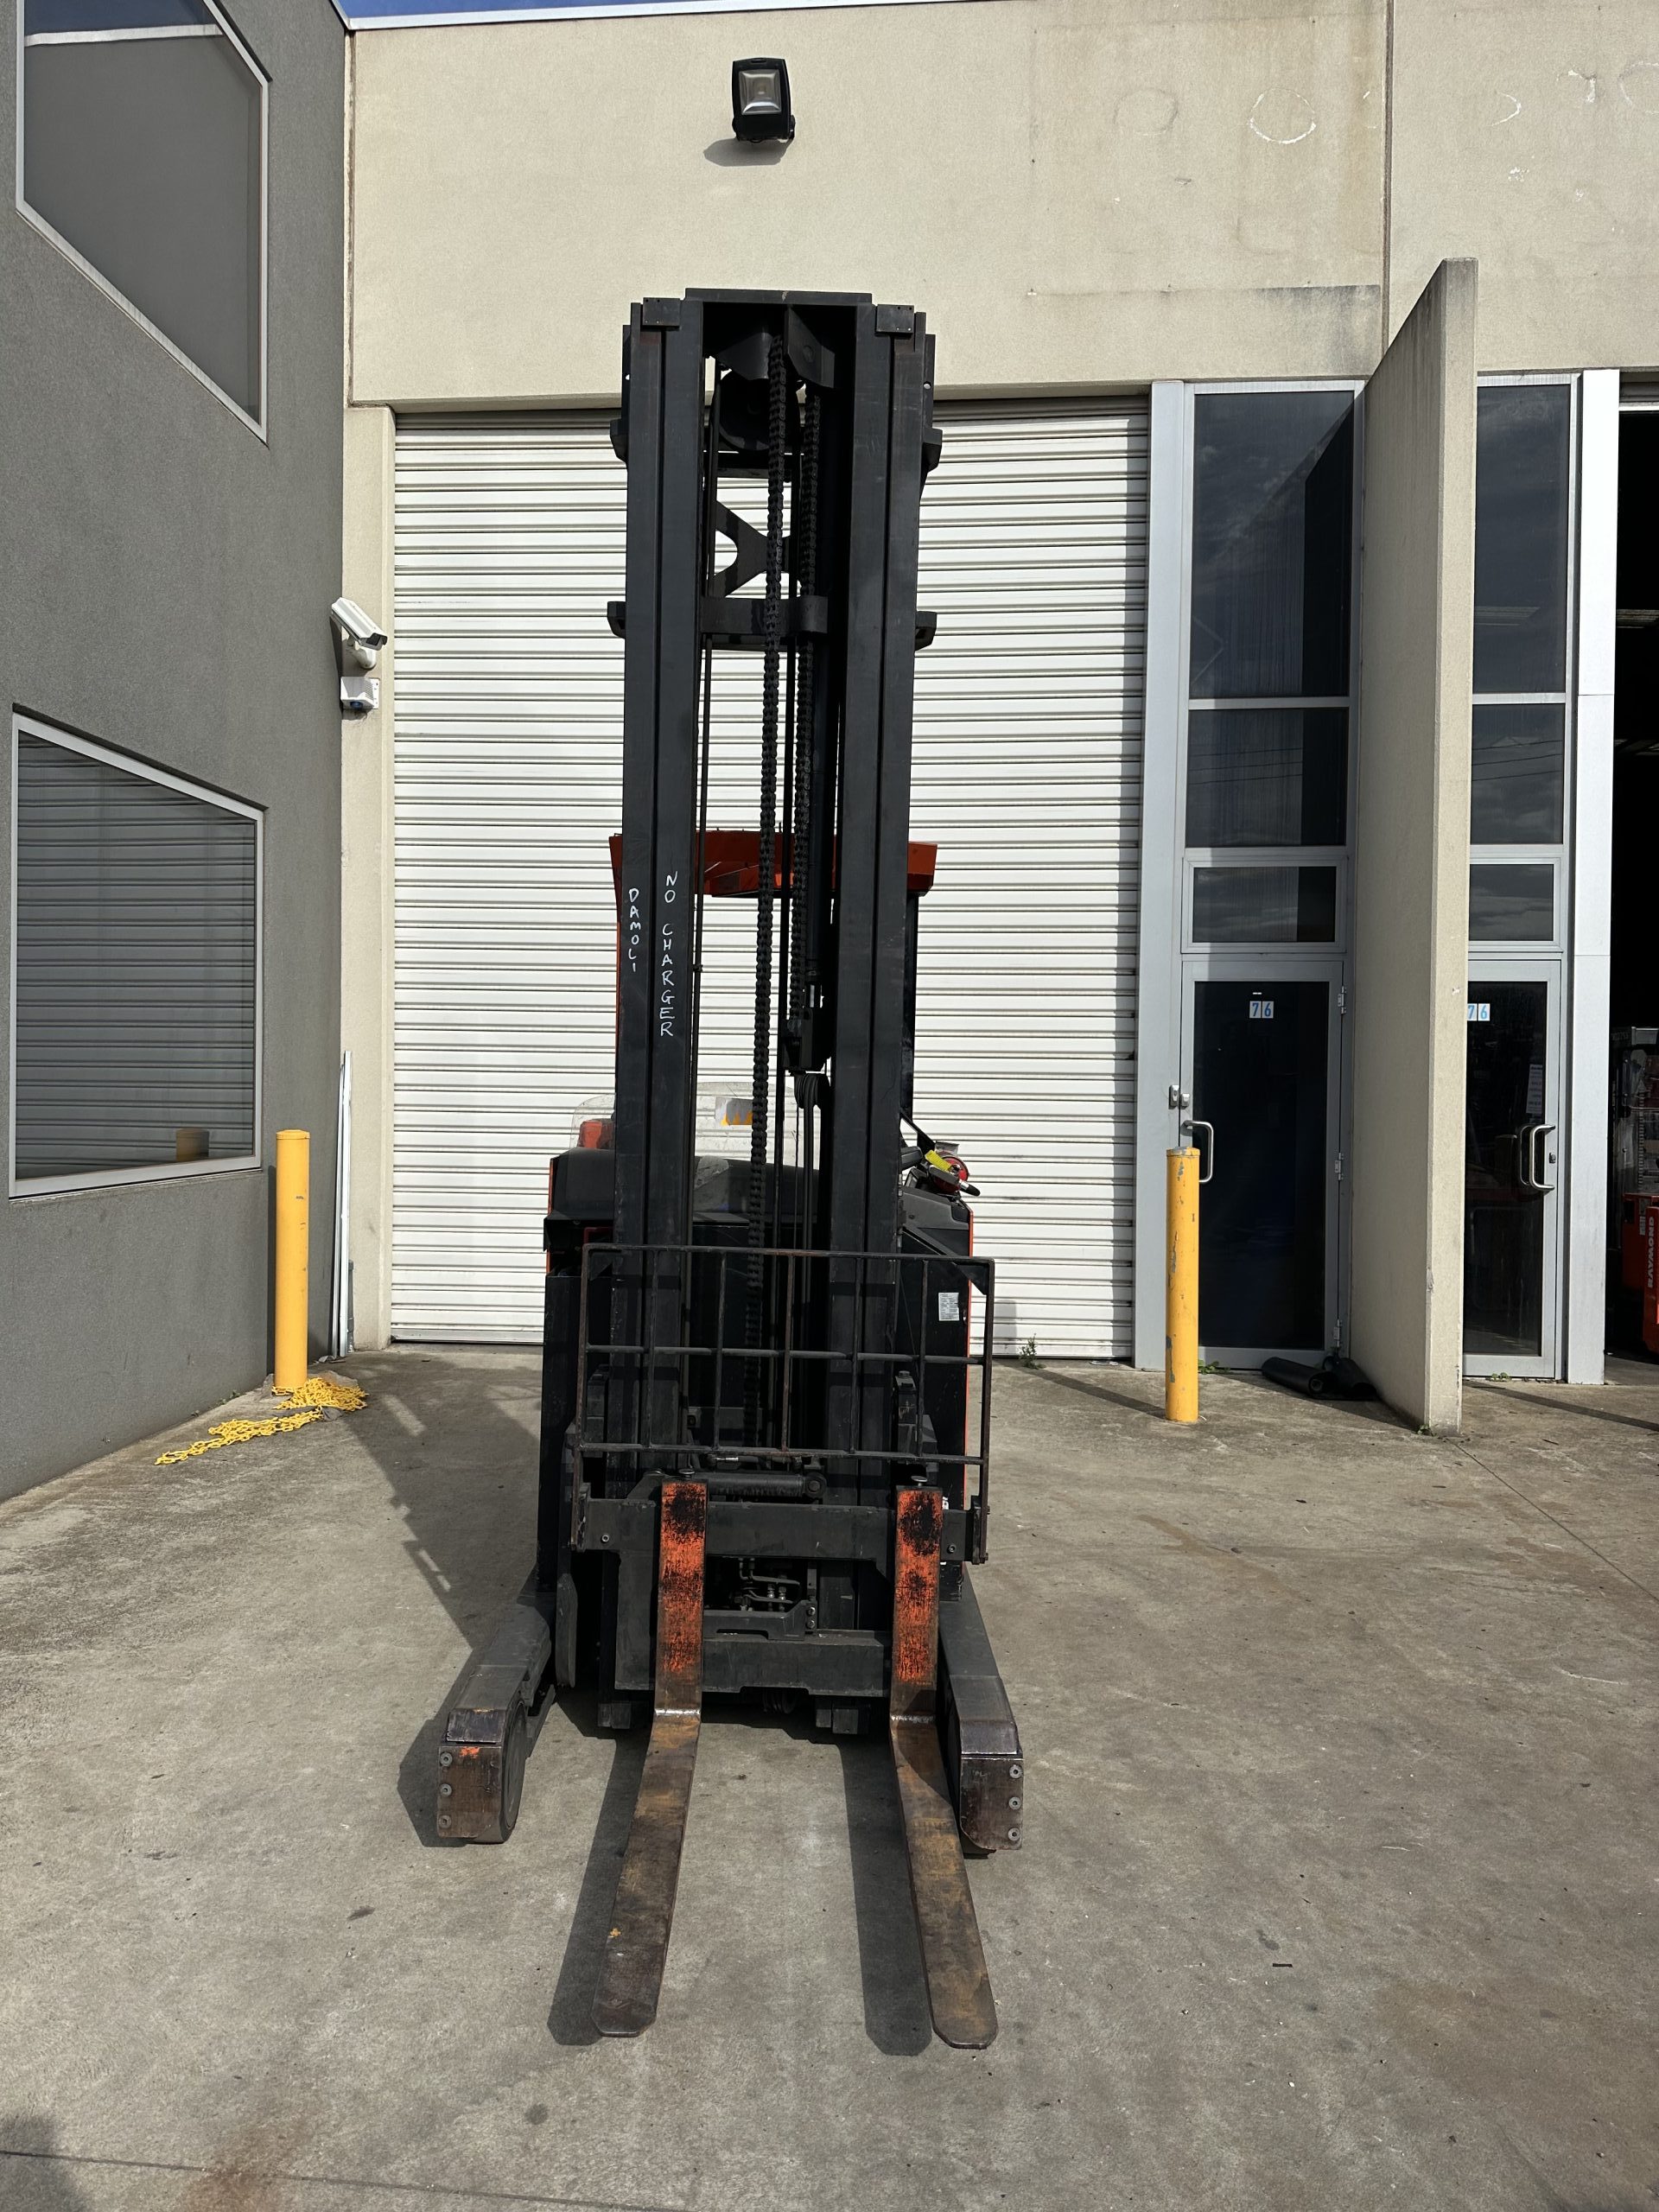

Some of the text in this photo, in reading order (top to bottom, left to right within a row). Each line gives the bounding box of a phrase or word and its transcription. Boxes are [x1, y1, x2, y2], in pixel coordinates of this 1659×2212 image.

[659, 871, 678, 1037] NO CHARGER
[1252, 1002, 1272, 1017] 76
[1468, 1004, 1488, 1020] 76
